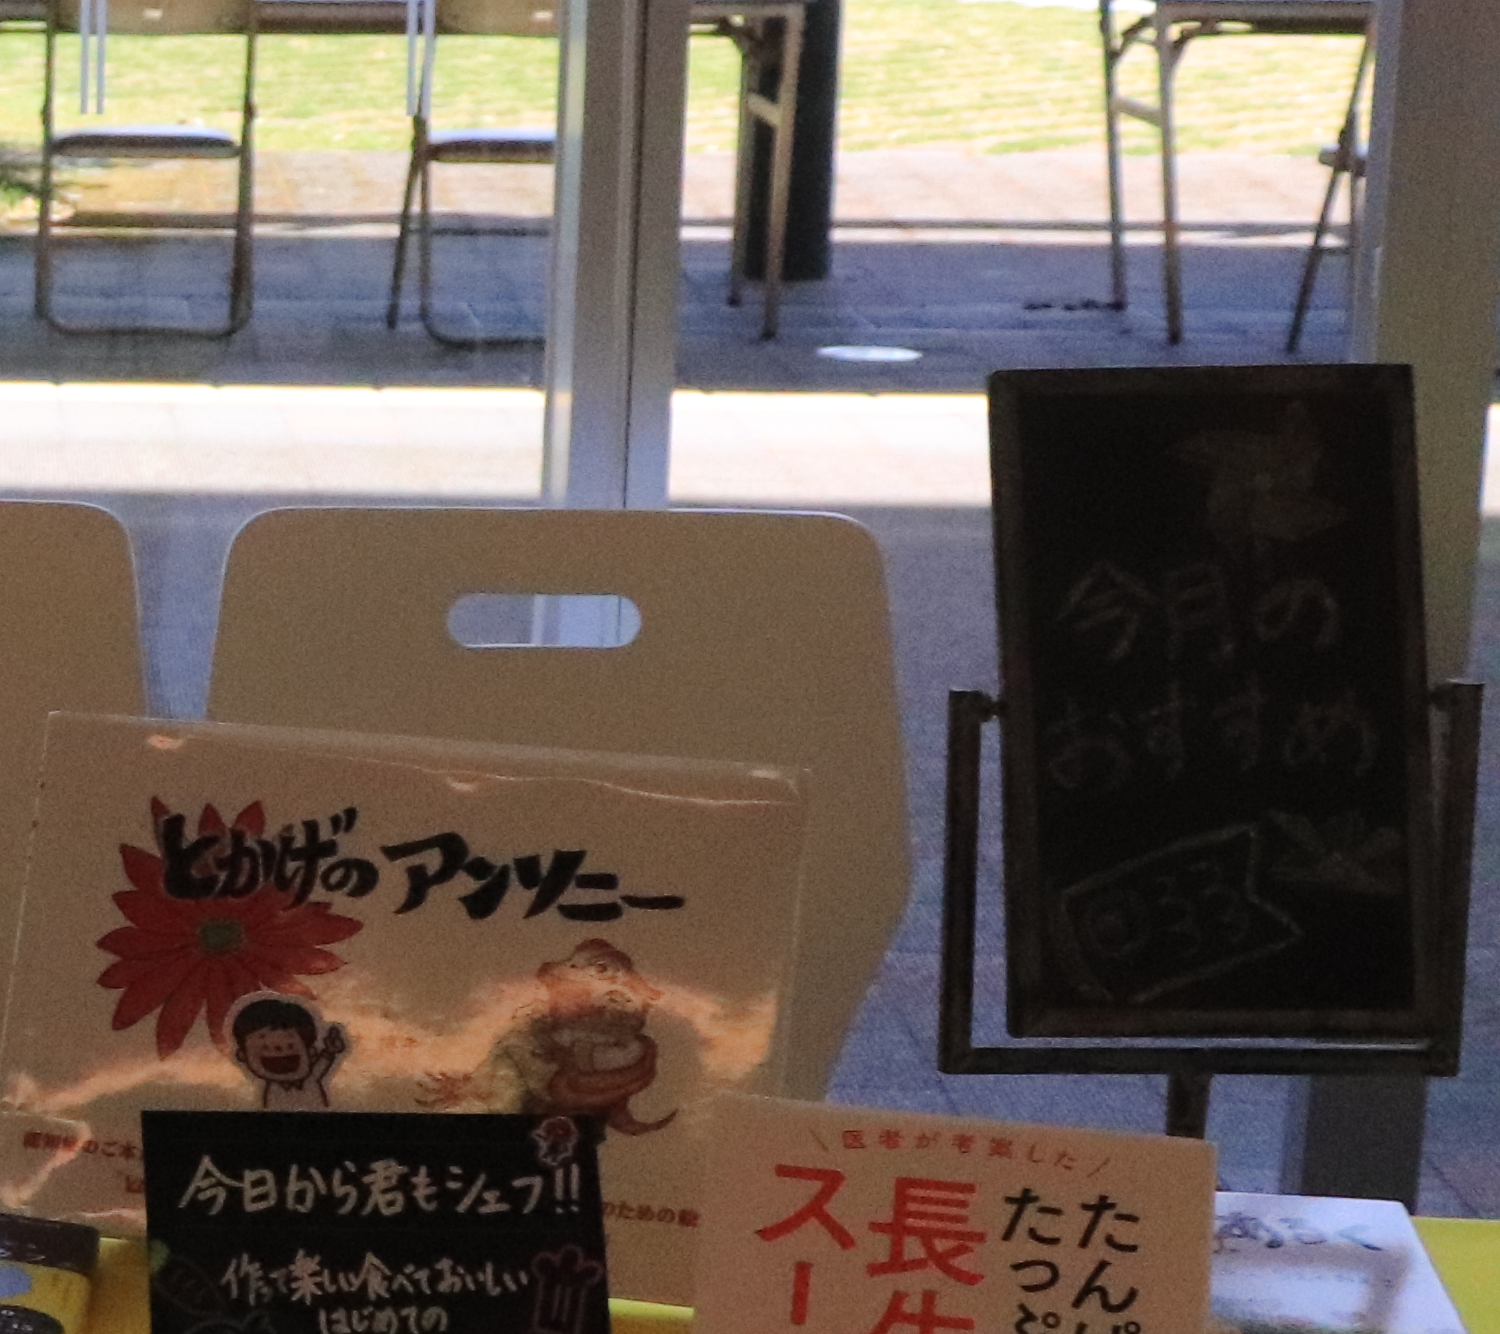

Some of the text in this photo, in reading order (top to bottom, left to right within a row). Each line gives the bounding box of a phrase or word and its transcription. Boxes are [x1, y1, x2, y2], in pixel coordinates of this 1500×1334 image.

[159, 807, 688, 921] とかげのアンソニー
